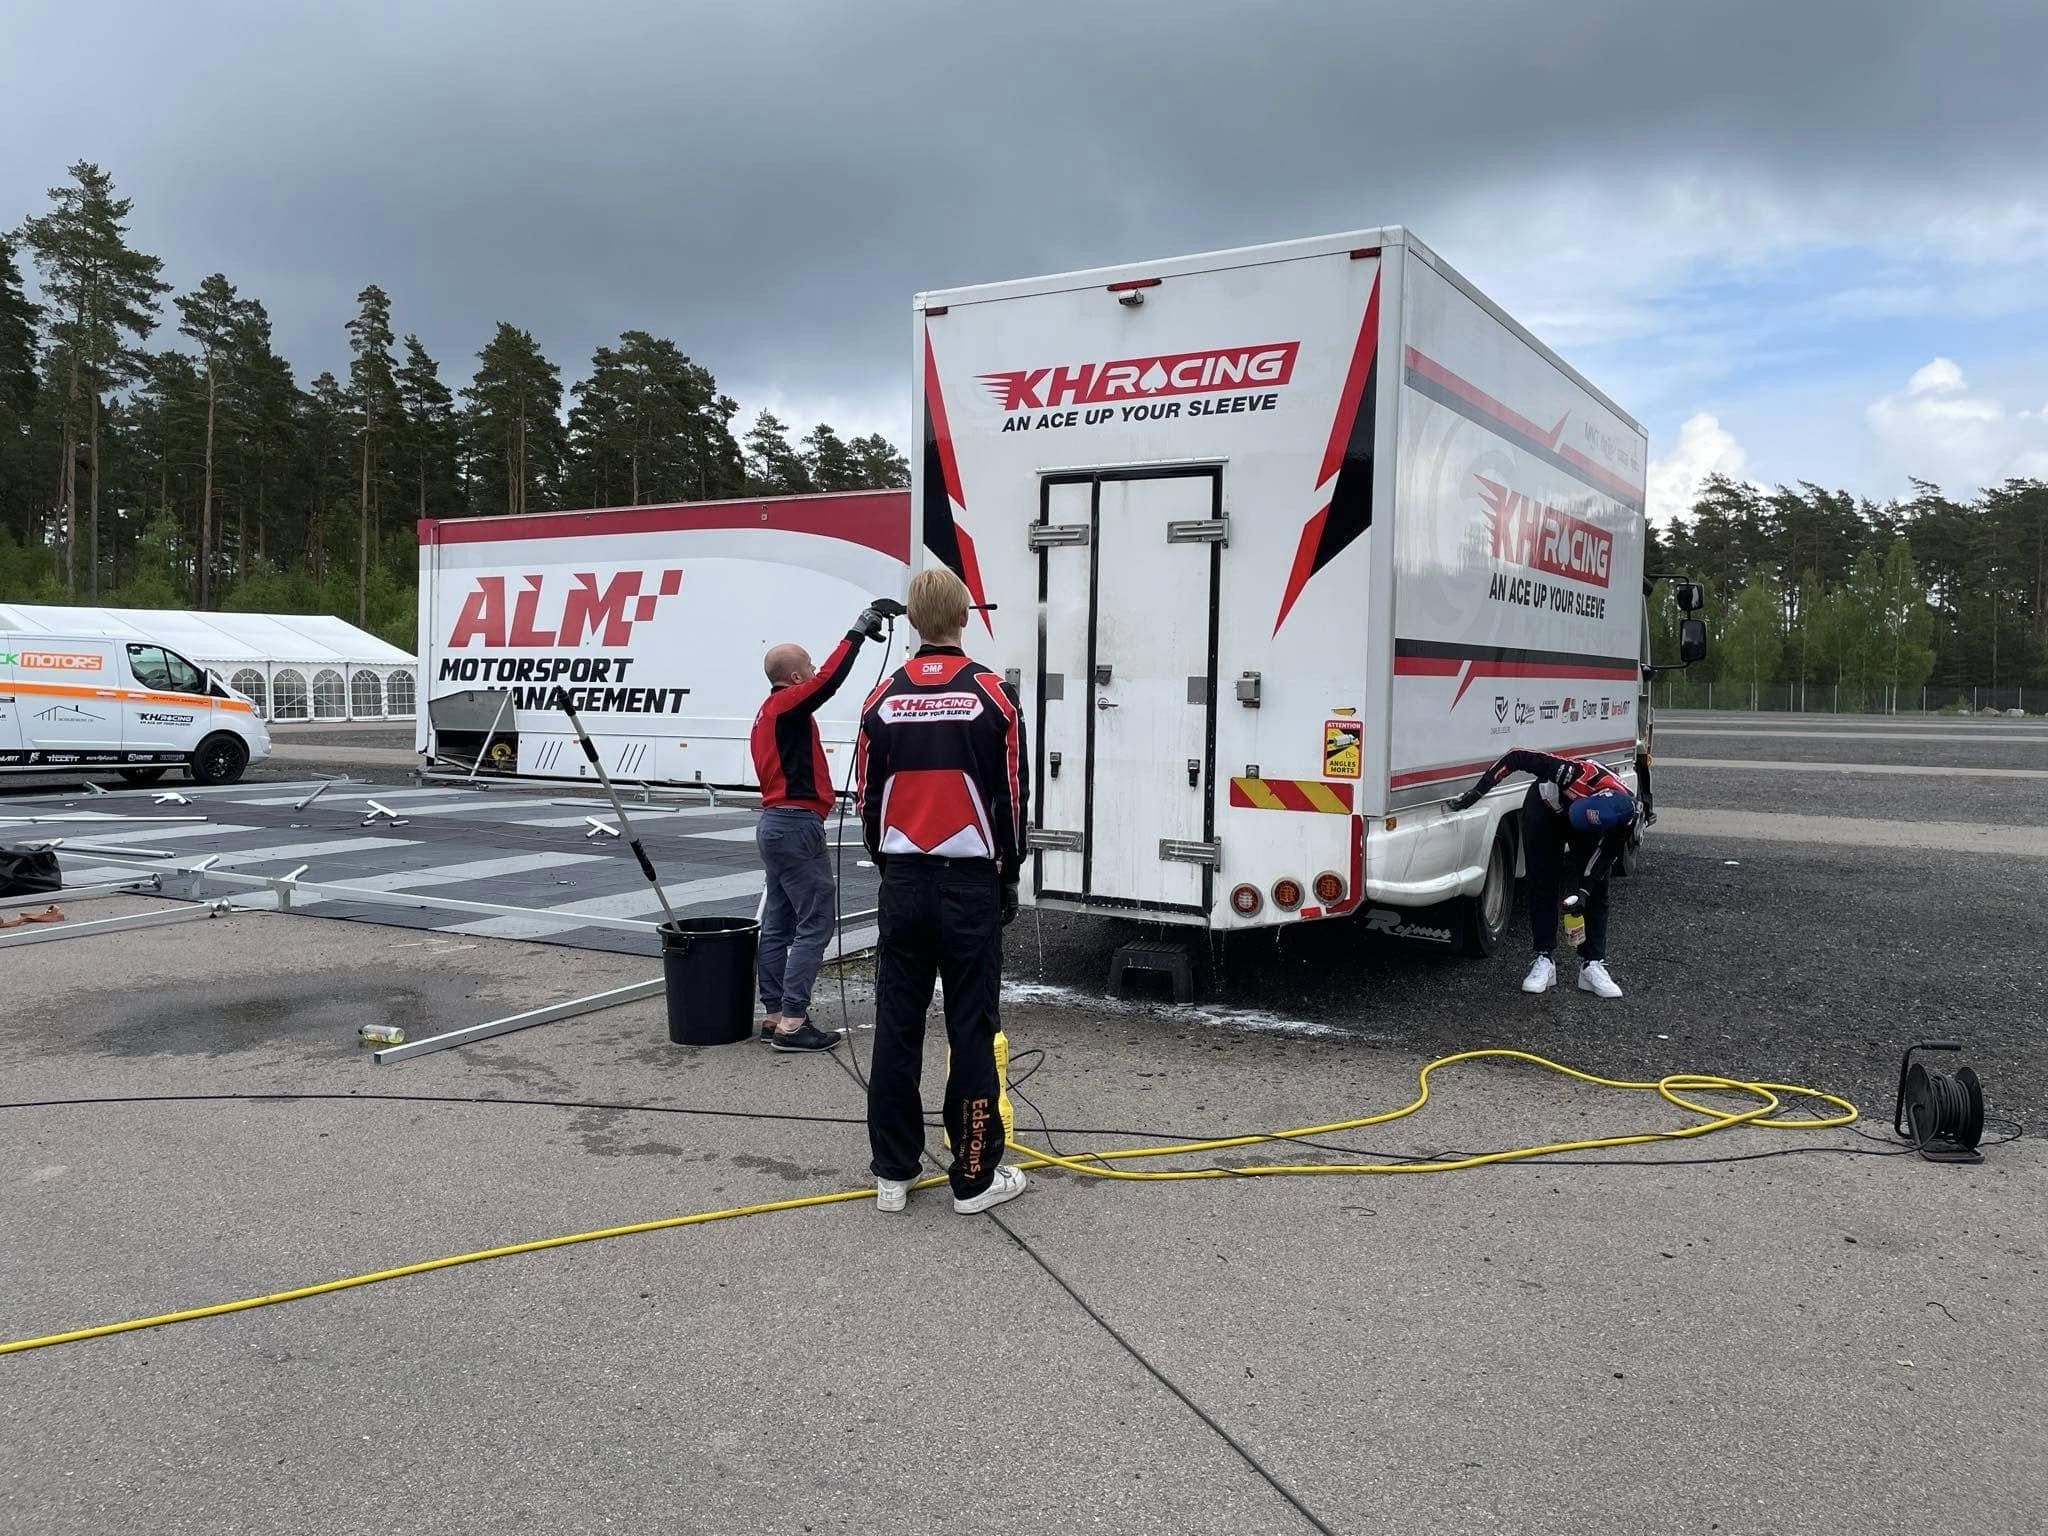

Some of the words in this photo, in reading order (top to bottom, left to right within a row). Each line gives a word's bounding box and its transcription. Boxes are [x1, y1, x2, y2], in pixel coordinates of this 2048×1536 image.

[1001, 416, 1030, 433] AN
[1035, 411, 1079, 430] ACE
[1084, 406, 1114, 425] UP
[1121, 402, 1182, 422] YOUR
[1187, 393, 1279, 417] SLEEVE
[448, 571, 643, 647] ALM
[1489, 573, 1507, 602] AN
[1508, 577, 1532, 606] ACE
[1533, 582, 1547, 609] UP
[1550, 586, 1574, 614] YOUR
[1575, 592, 1605, 620] SLEEVE
[22, 653, 101, 669] MOTORS
[438, 658, 634, 683] MOTORSPORT
[922, 664, 943, 673] OMP
[488, 686, 690, 714] ANAGEMENT
[930, 709, 945, 717] YOUR
[1329, 760, 1356, 768] ANGLES
